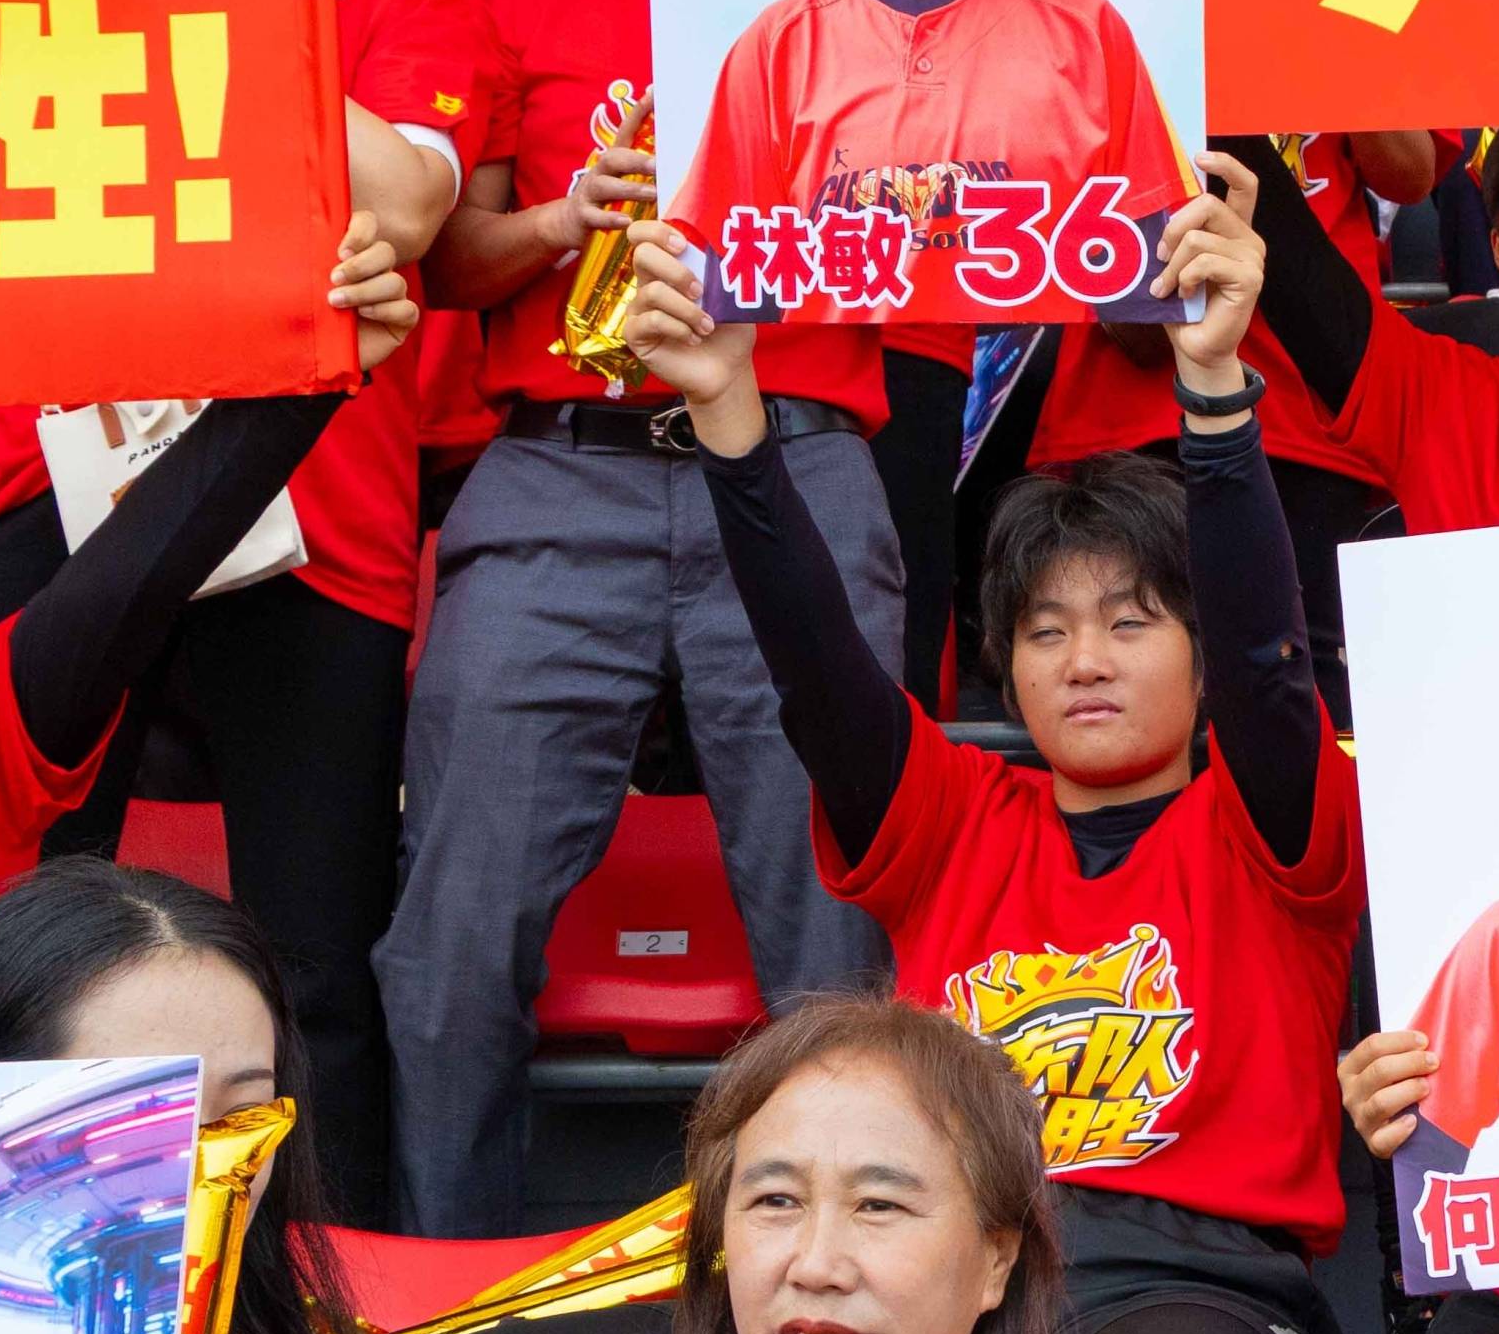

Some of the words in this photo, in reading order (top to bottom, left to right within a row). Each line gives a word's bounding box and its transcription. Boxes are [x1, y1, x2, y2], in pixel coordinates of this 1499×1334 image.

[720, 205, 915, 309] 林敏
[953, 175, 1149, 309] 36
[645, 934, 662, 953] 2
